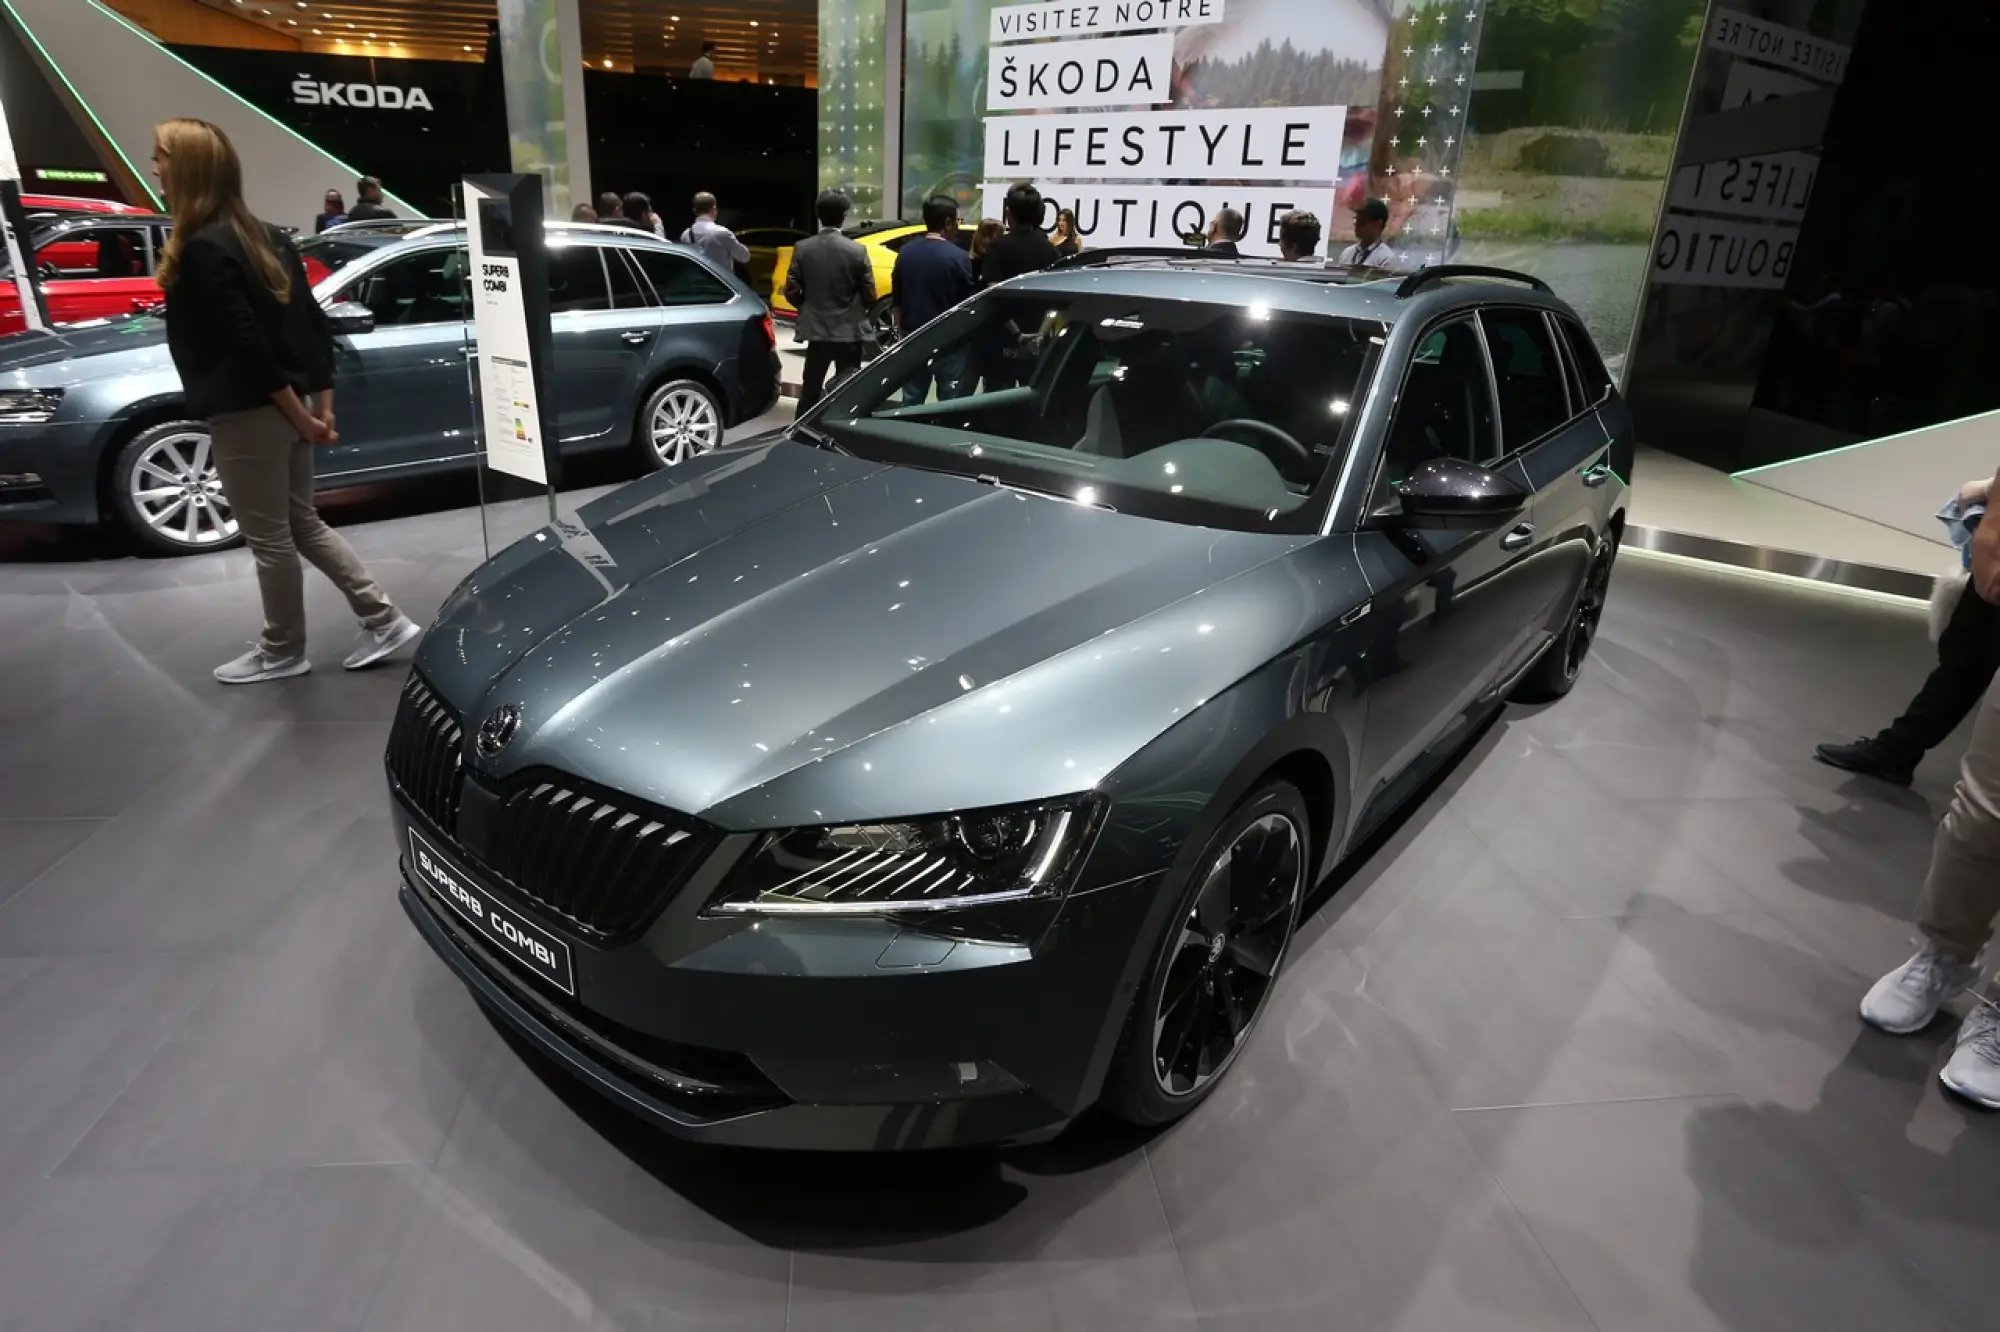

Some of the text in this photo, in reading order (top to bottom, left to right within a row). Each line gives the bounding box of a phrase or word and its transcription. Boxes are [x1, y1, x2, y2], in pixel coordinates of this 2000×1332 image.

[1000, 0, 1211, 34] VISITEZ NOTRE
[291, 73, 434, 111] ŠKODA
[999, 56, 1153, 98] ŠKODA
[1003, 123, 1310, 166] LIFESTYLE
[1002, 197, 1295, 243] OUTIQUE
[419, 850, 556, 969] SUPERB COMBI
